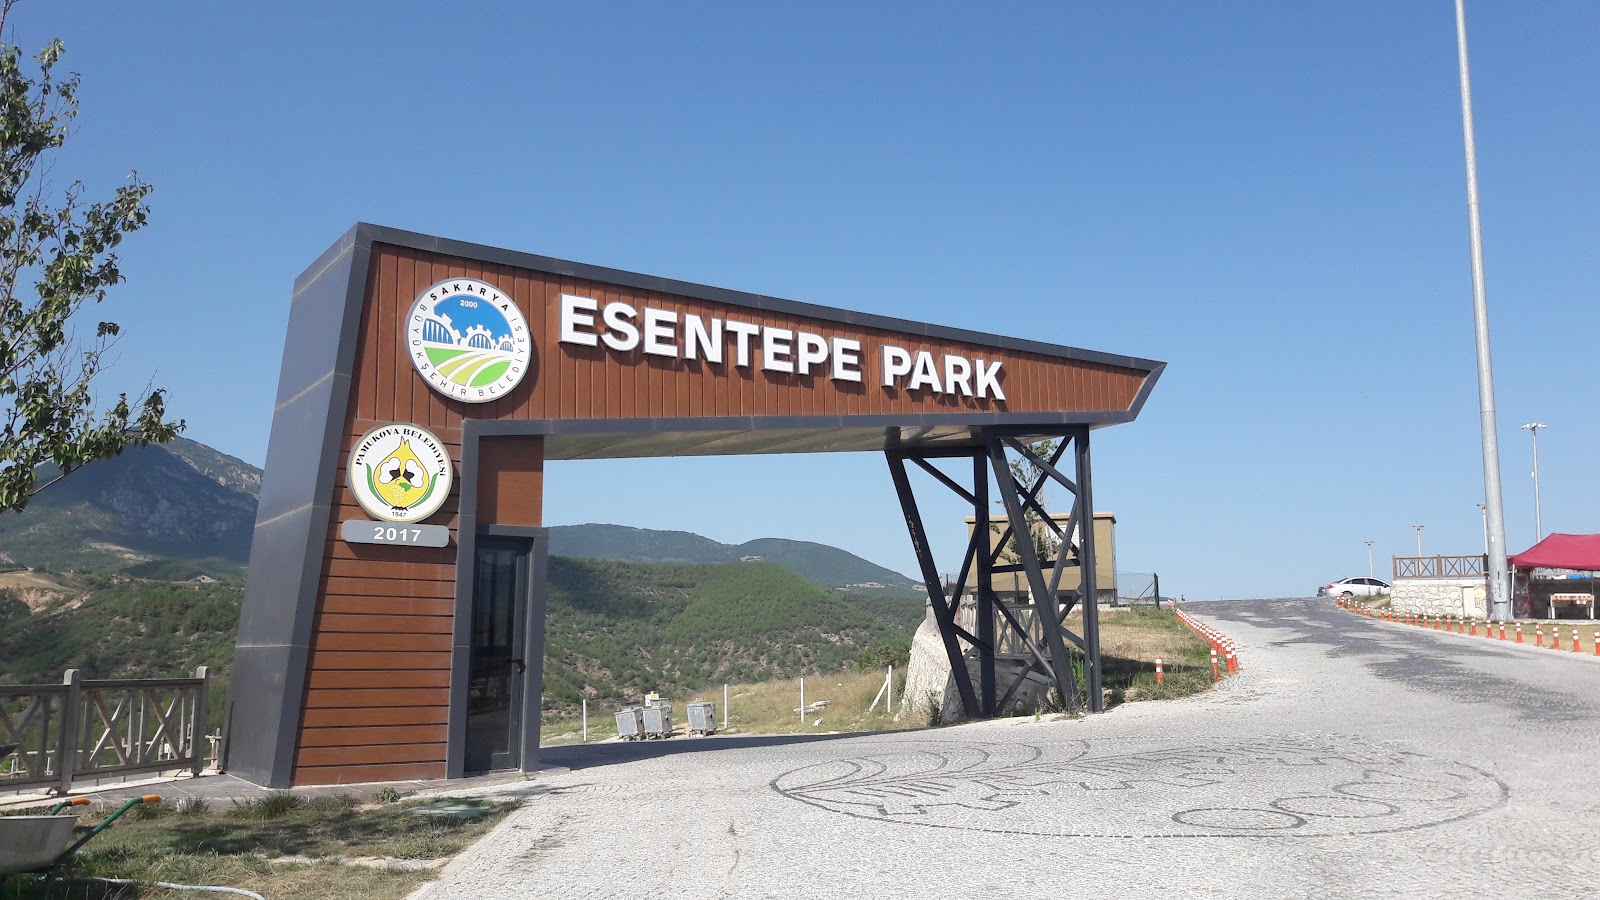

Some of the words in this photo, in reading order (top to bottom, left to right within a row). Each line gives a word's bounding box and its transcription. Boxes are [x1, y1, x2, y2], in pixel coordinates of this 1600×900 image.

[430, 283, 509, 312] SAKARYA
[459, 299, 478, 309] 2000
[558, 293, 862, 383] ESENTEPE
[880, 345, 1006, 401] PARK
[355, 428, 400, 466] PAMUKOVA
[373, 526, 422, 542] 2017
